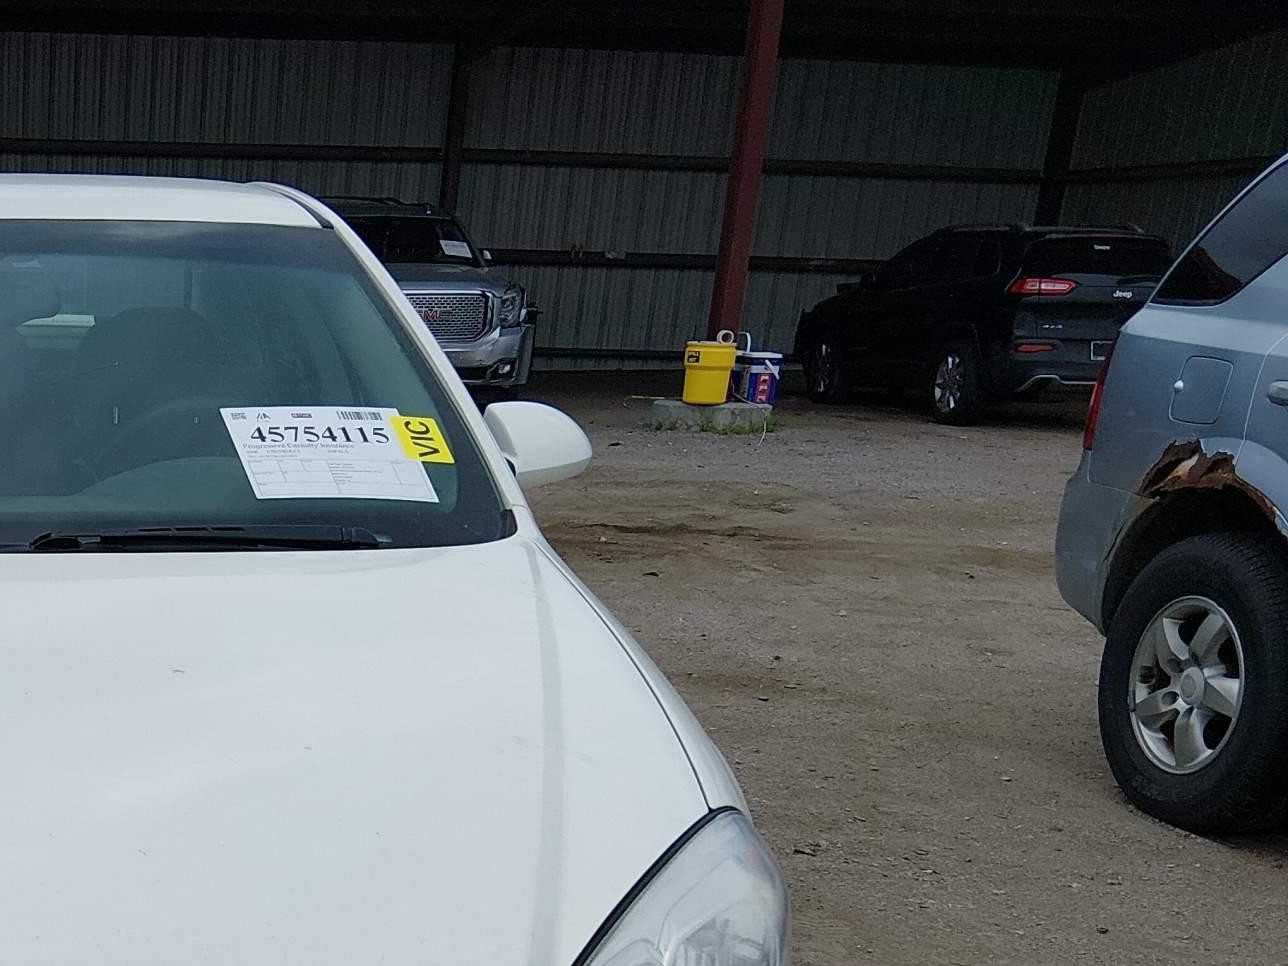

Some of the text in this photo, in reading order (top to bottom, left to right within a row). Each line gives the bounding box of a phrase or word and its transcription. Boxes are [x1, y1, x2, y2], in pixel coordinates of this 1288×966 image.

[1113, 289, 1133, 299] Jeep
[250, 426, 390, 444] 45754115
[403, 420, 441, 458] VIC
